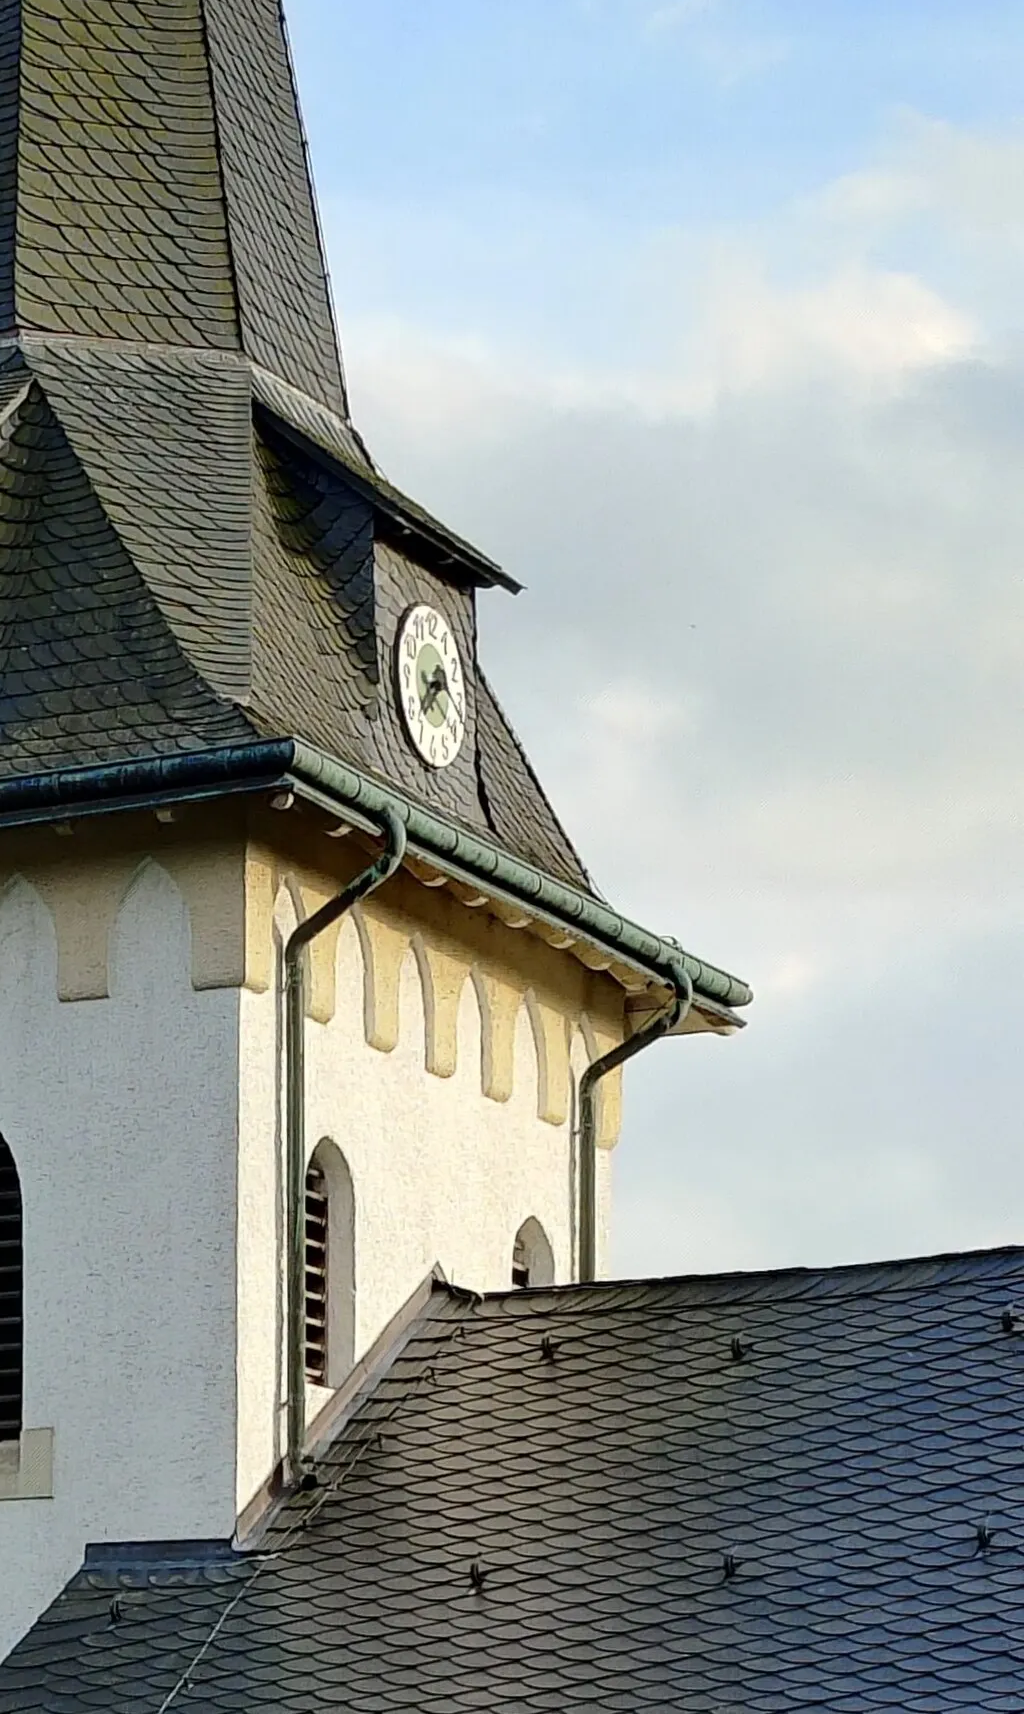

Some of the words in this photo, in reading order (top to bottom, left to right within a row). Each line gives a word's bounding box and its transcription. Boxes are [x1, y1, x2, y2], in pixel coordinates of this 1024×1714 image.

[413, 614, 424, 641] 11
[425, 611, 438, 640] 12
[404, 634, 416, 659] 10
[441, 631, 448, 655] 1
[451, 658, 457, 682] 2
